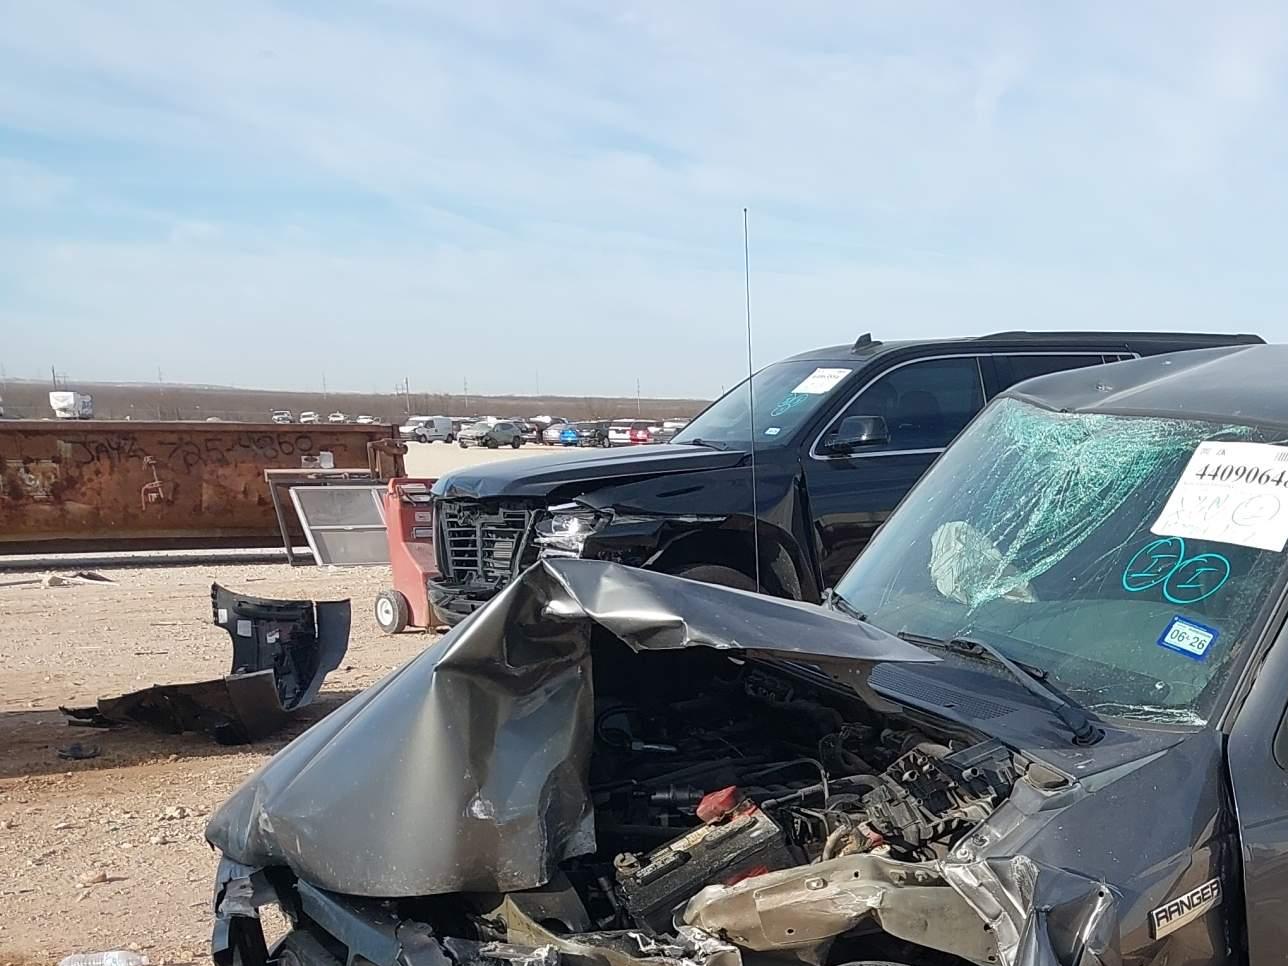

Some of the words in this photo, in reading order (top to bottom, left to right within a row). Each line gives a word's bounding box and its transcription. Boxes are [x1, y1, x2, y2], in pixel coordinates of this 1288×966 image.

[1169, 628, 1187, 643] 06
[1189, 636, 1208, 651] 26
[1156, 880, 1221, 926] RANGER
